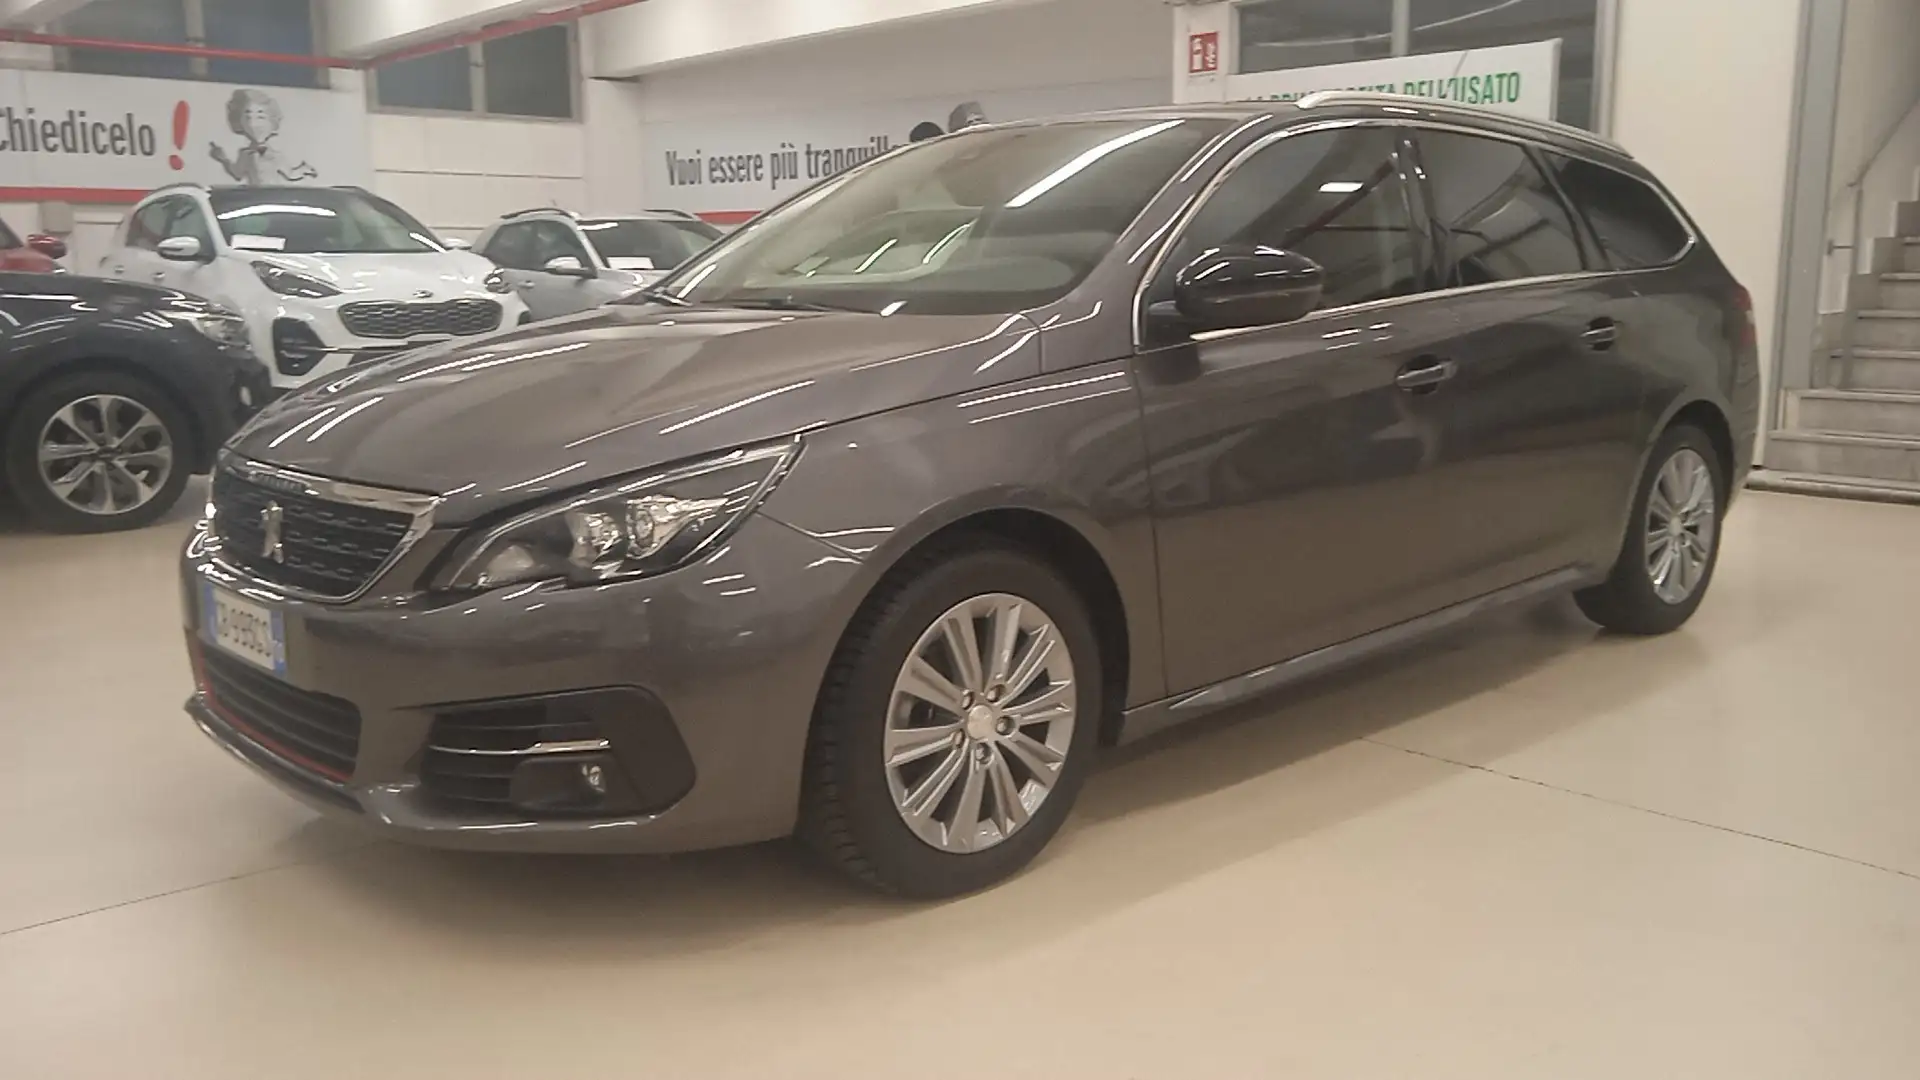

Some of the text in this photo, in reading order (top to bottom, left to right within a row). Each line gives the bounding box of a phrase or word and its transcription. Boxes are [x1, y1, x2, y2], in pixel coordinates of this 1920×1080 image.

[709, 153, 764, 184] essere
[770, 142, 798, 190] più
[805, 135, 908, 179] tranquil
